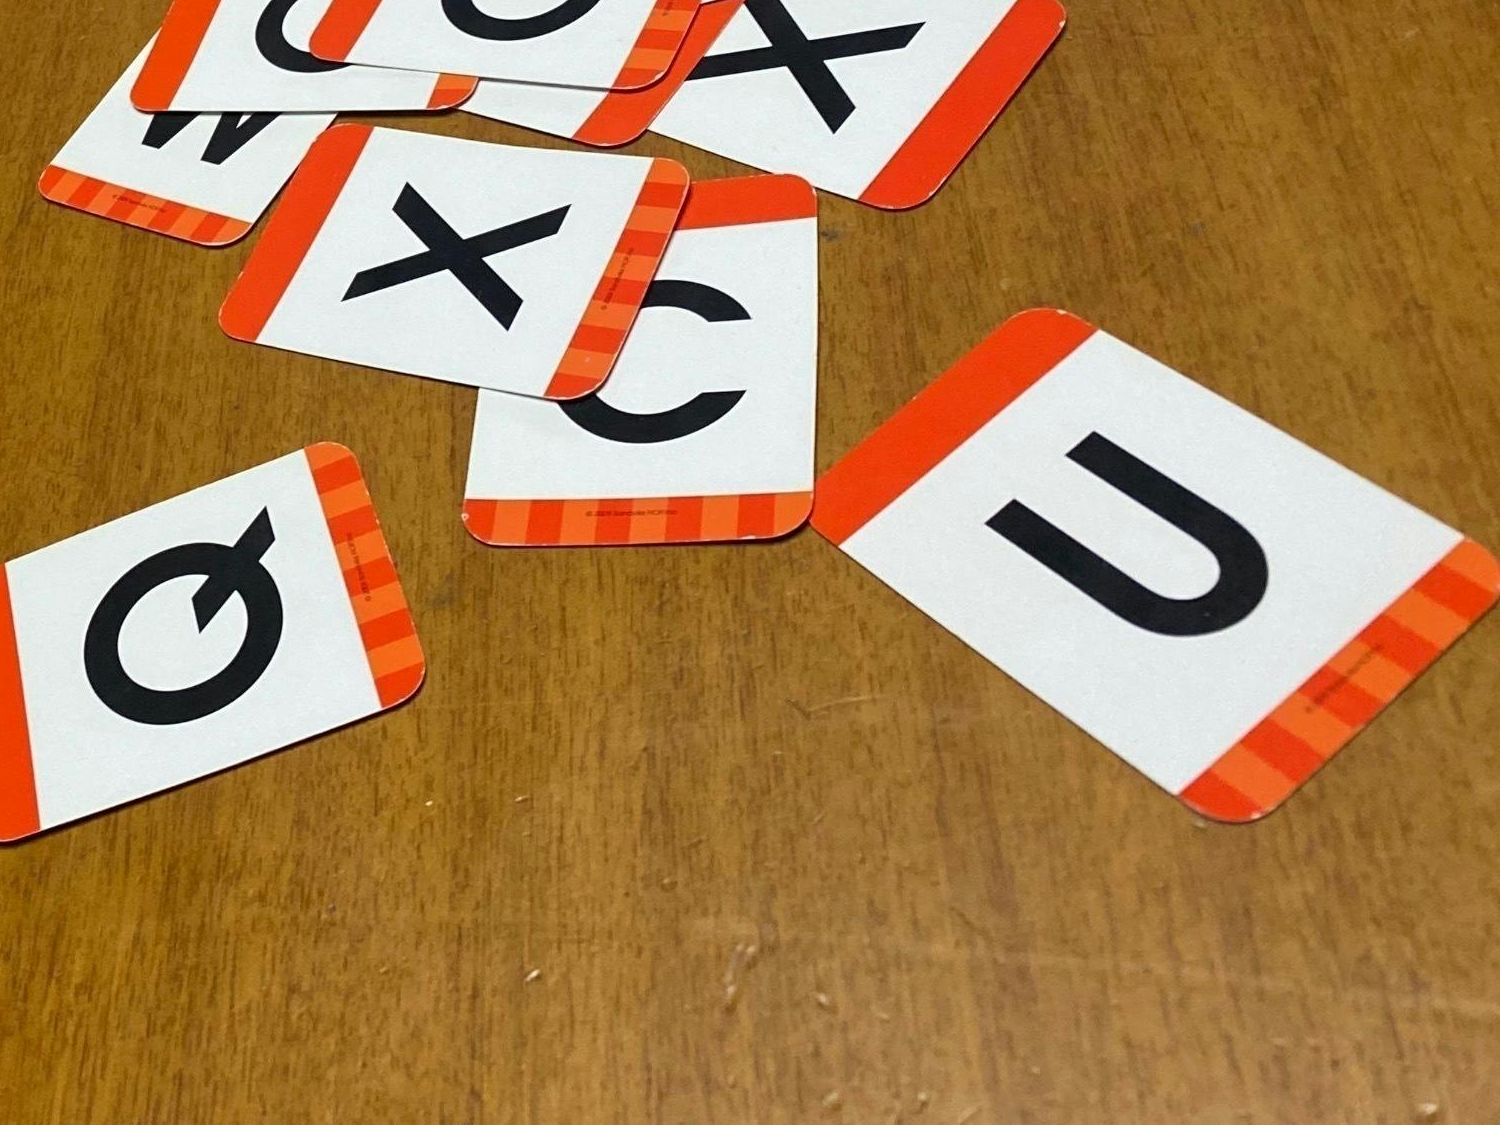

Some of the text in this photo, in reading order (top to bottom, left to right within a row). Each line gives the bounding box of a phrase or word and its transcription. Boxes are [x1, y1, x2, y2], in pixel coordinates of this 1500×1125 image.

[342, 182, 571, 331] X
[557, 279, 752, 444] C
[83, 506, 284, 726] Q
[985, 431, 1269, 637] U
